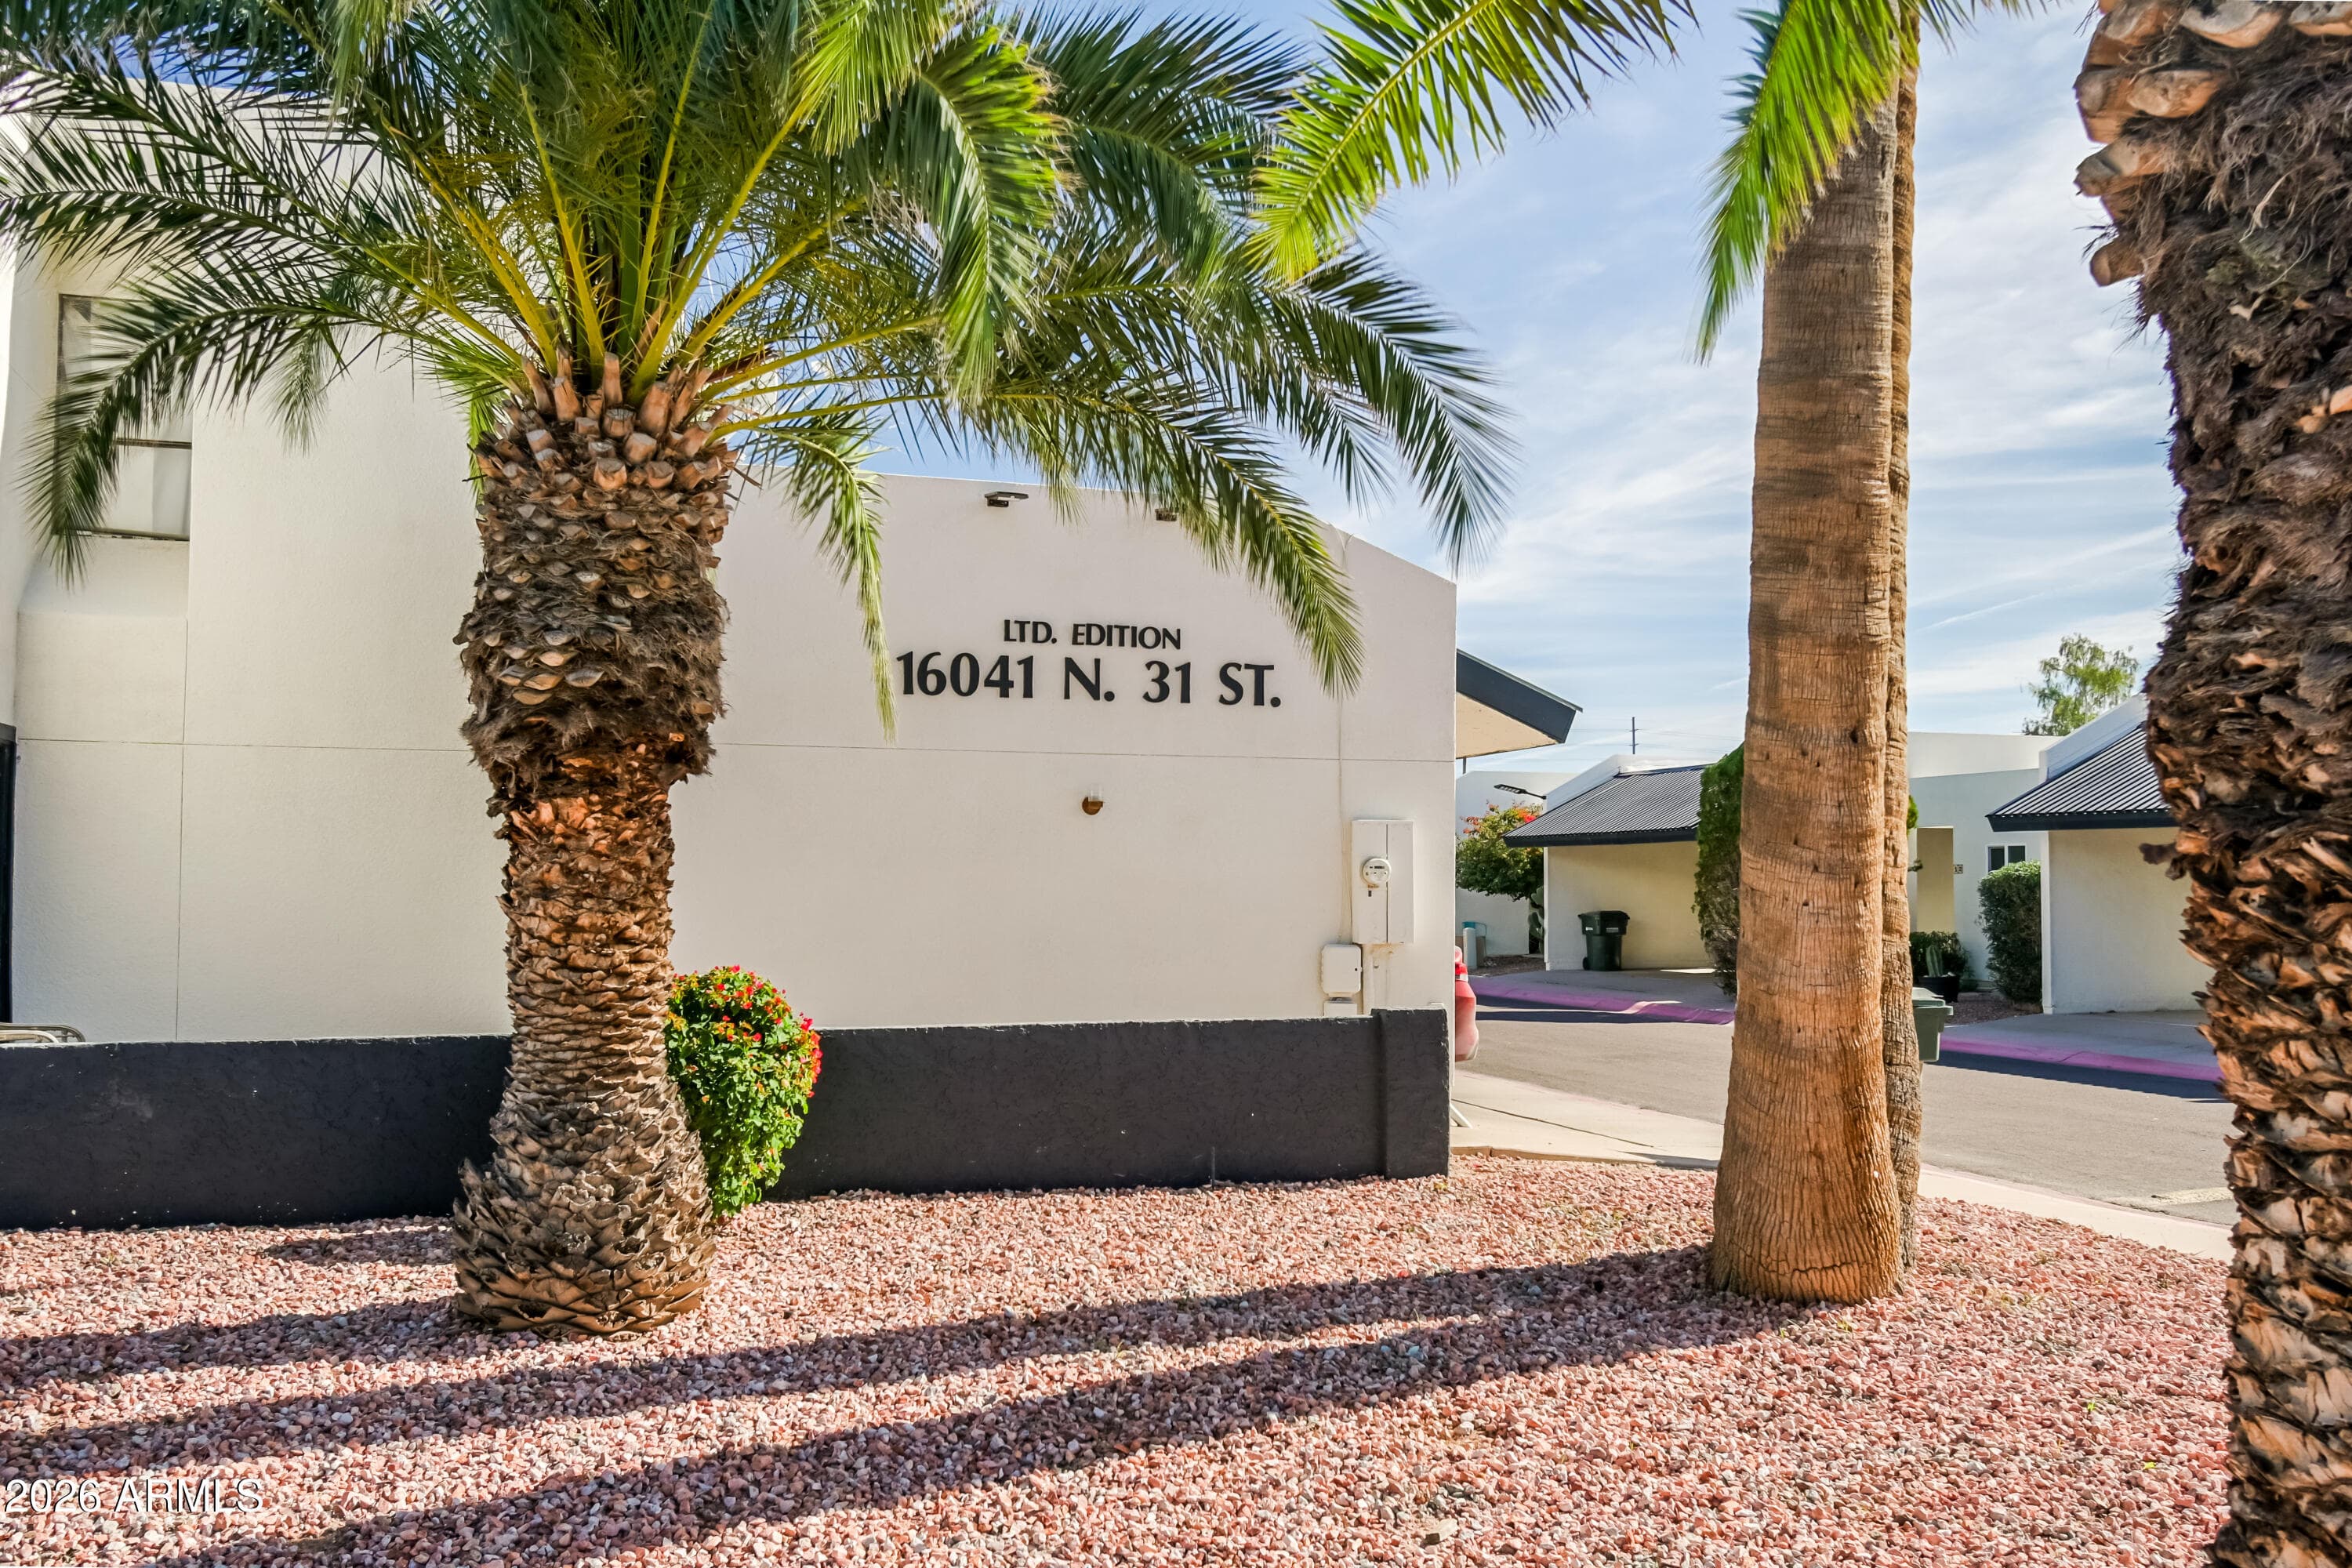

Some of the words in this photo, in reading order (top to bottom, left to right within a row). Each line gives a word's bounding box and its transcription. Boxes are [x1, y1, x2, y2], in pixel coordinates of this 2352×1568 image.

[1004, 619, 1058, 644] LTD.
[1071, 622, 1181, 650] EDITION
[895, 650, 1034, 699] 16041
[1063, 656, 1116, 702] N.
[1142, 660, 1191, 704] 31
[1218, 662, 1282, 708] ST.
